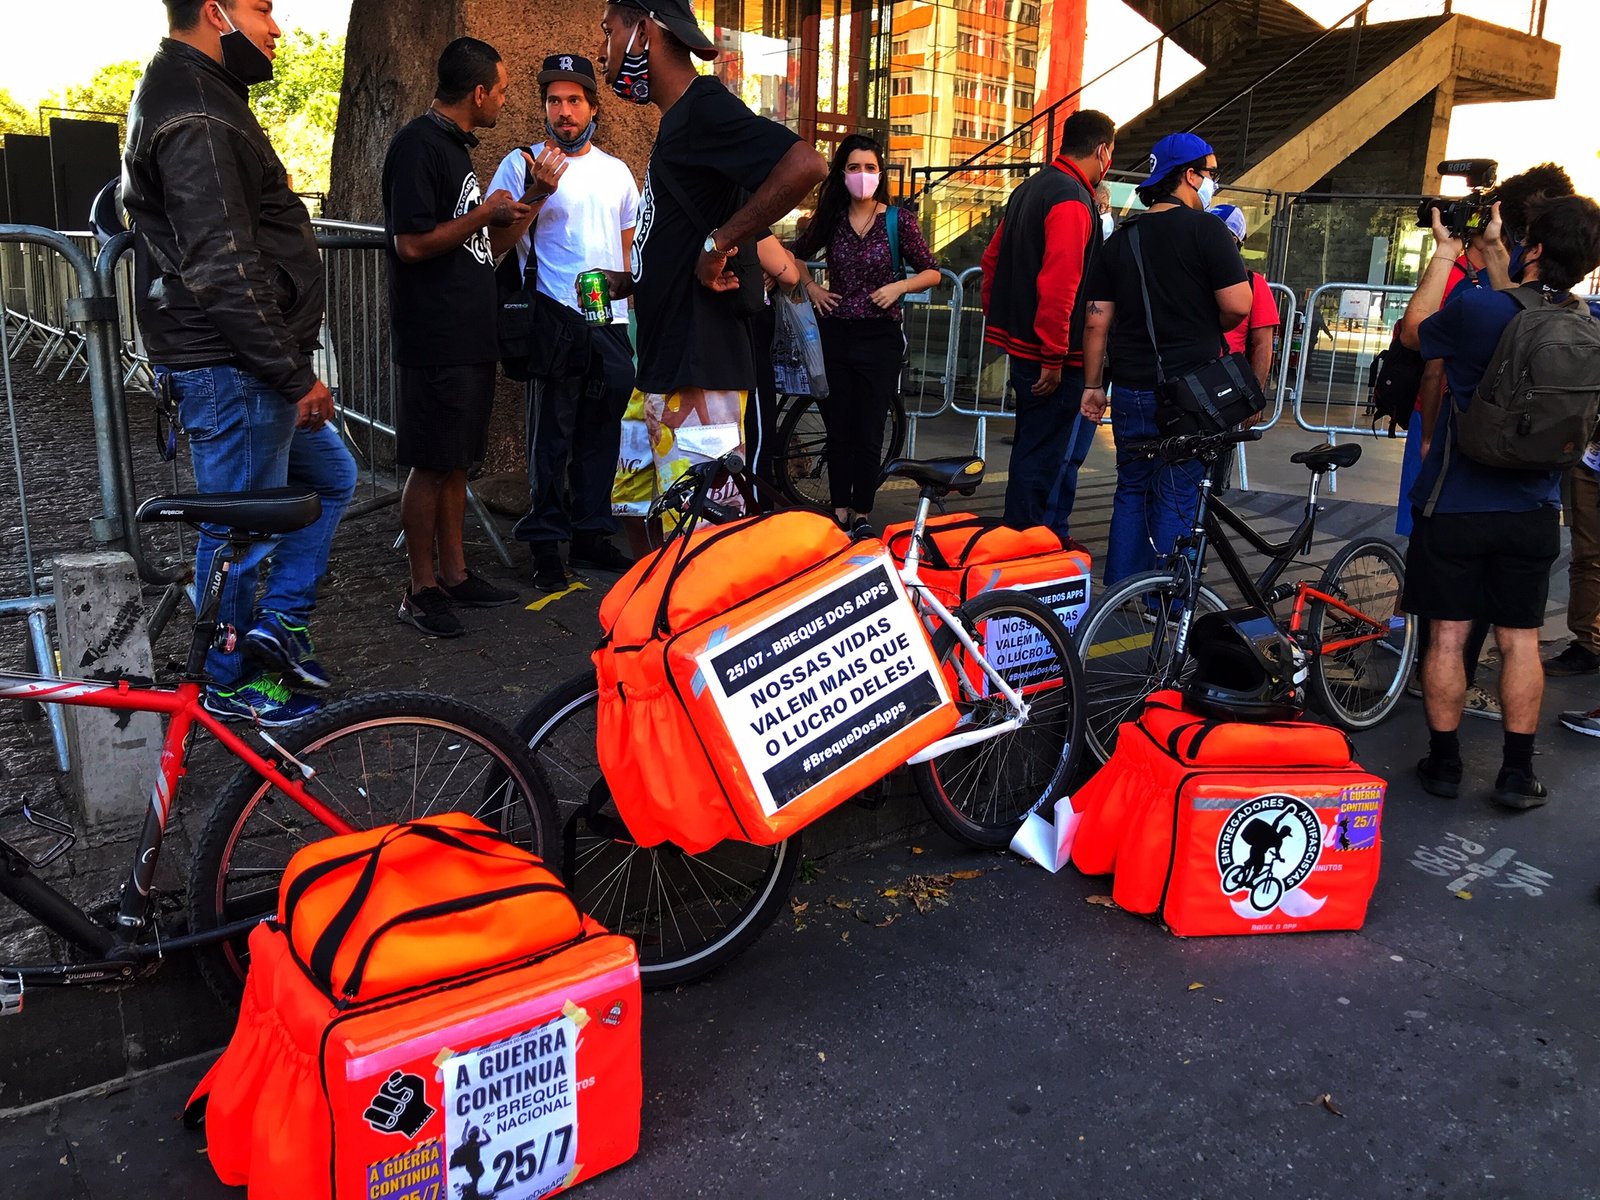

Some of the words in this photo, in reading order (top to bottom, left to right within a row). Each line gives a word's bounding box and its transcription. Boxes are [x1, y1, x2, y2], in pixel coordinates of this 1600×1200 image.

[211, 571, 223, 597] CALOI
[1052, 592, 1066, 603] DOS
[1066, 589, 1084, 600] APPS
[725, 655, 765, 682] 25/07
[772, 617, 826, 654] BREQUE
[825, 601, 853, 624] DOS
[855, 582, 889, 609] APPS
[996, 635, 1032, 650] VALEM
[1002, 620, 1035, 634] NOSS
[750, 651, 832, 708] NOSSAS
[832, 617, 891, 659] VIDAS
[997, 655, 1005, 665] O
[1008, 648, 1043, 663] LUCRO
[750, 687, 818, 736] VALEM
[819, 658, 867, 695] MAIS
[870, 633, 910, 664] QUE
[765, 739, 780, 757] O
[782, 697, 848, 746] LUCRO
[850, 656, 916, 705] DELES!
[802, 701, 907, 773] #BrequeDosApps
[1341, 801, 1379, 813] CONTINUA
[1342, 792, 1348, 801] A
[1350, 790, 1381, 801] GUERRA
[1222, 799, 1284, 865] ENTREGADORES
[1287, 810, 1318, 886] ANTIFASCISTAS
[455, 1064, 470, 1089] A
[479, 1027, 567, 1080] GUERRA
[456, 1056, 567, 1117] CONTINUA
[497, 1079, 569, 1120] BREQUE
[496, 1098, 572, 1135] NACIONAL
[370, 1168, 379, 1183] A
[384, 1146, 439, 1178] GUERRA
[492, 1124, 574, 1192] 25/7
[370, 1163, 440, 1199] CONTINUA
[399, 1182, 440, 1200] 5/7
